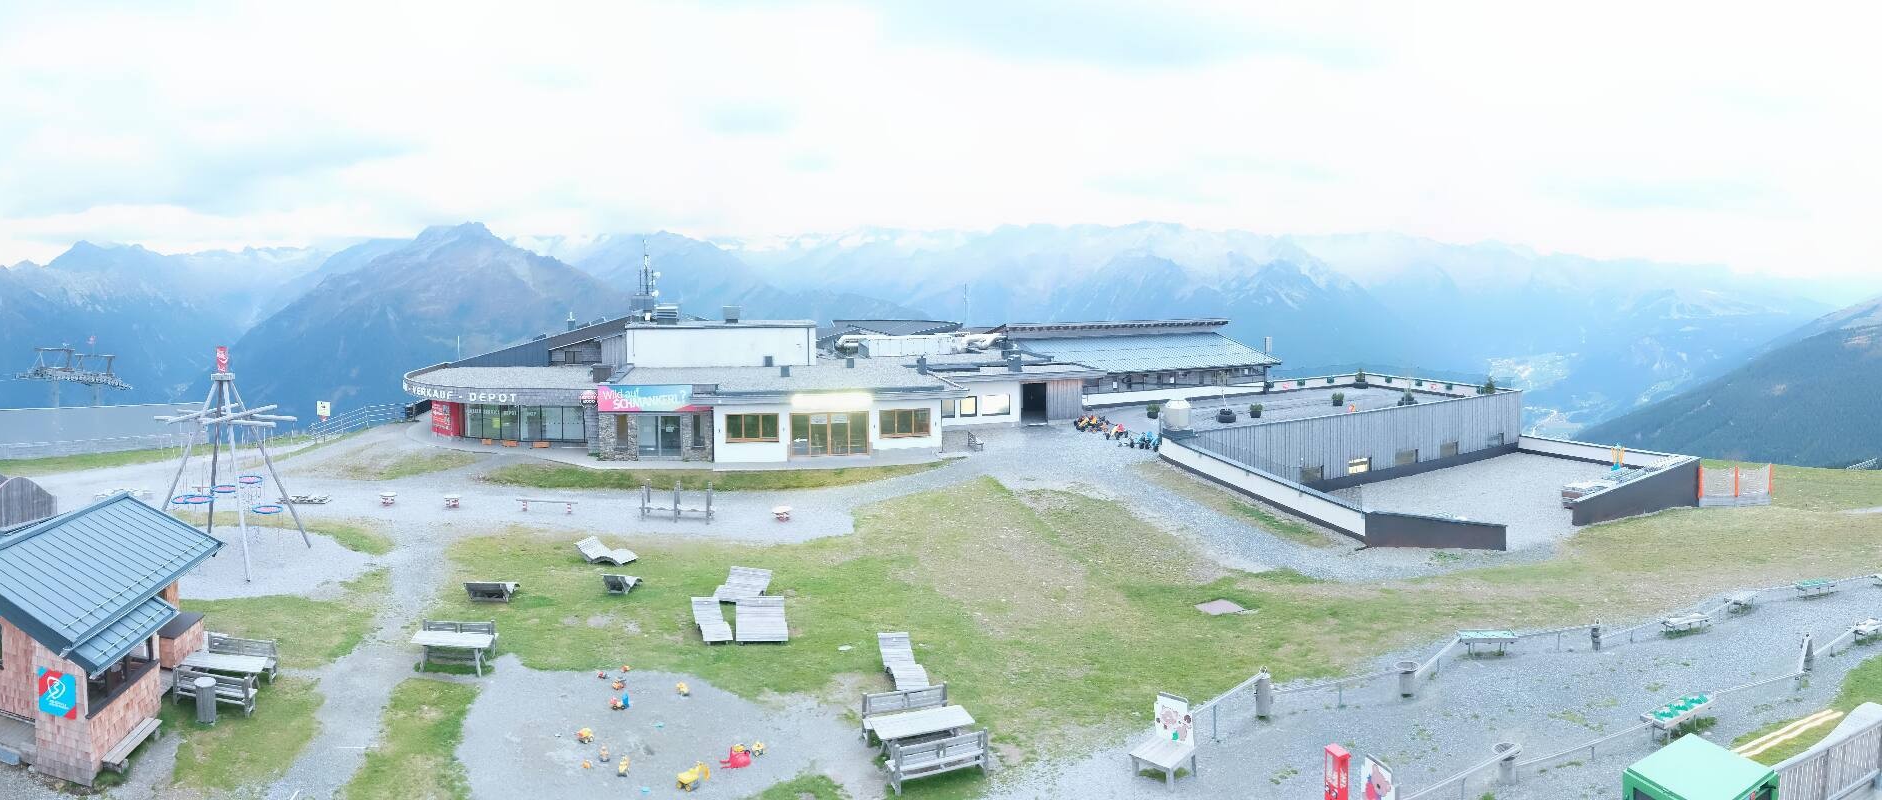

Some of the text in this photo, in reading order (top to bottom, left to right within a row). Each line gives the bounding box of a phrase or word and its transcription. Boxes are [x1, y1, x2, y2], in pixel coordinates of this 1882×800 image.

[412, 385, 453, 399] VERKAUF
[469, 392, 517, 403] DEPOT
[602, 387, 639, 400] Wild auf
[612, 389, 686, 409] SCHMANKERL?
